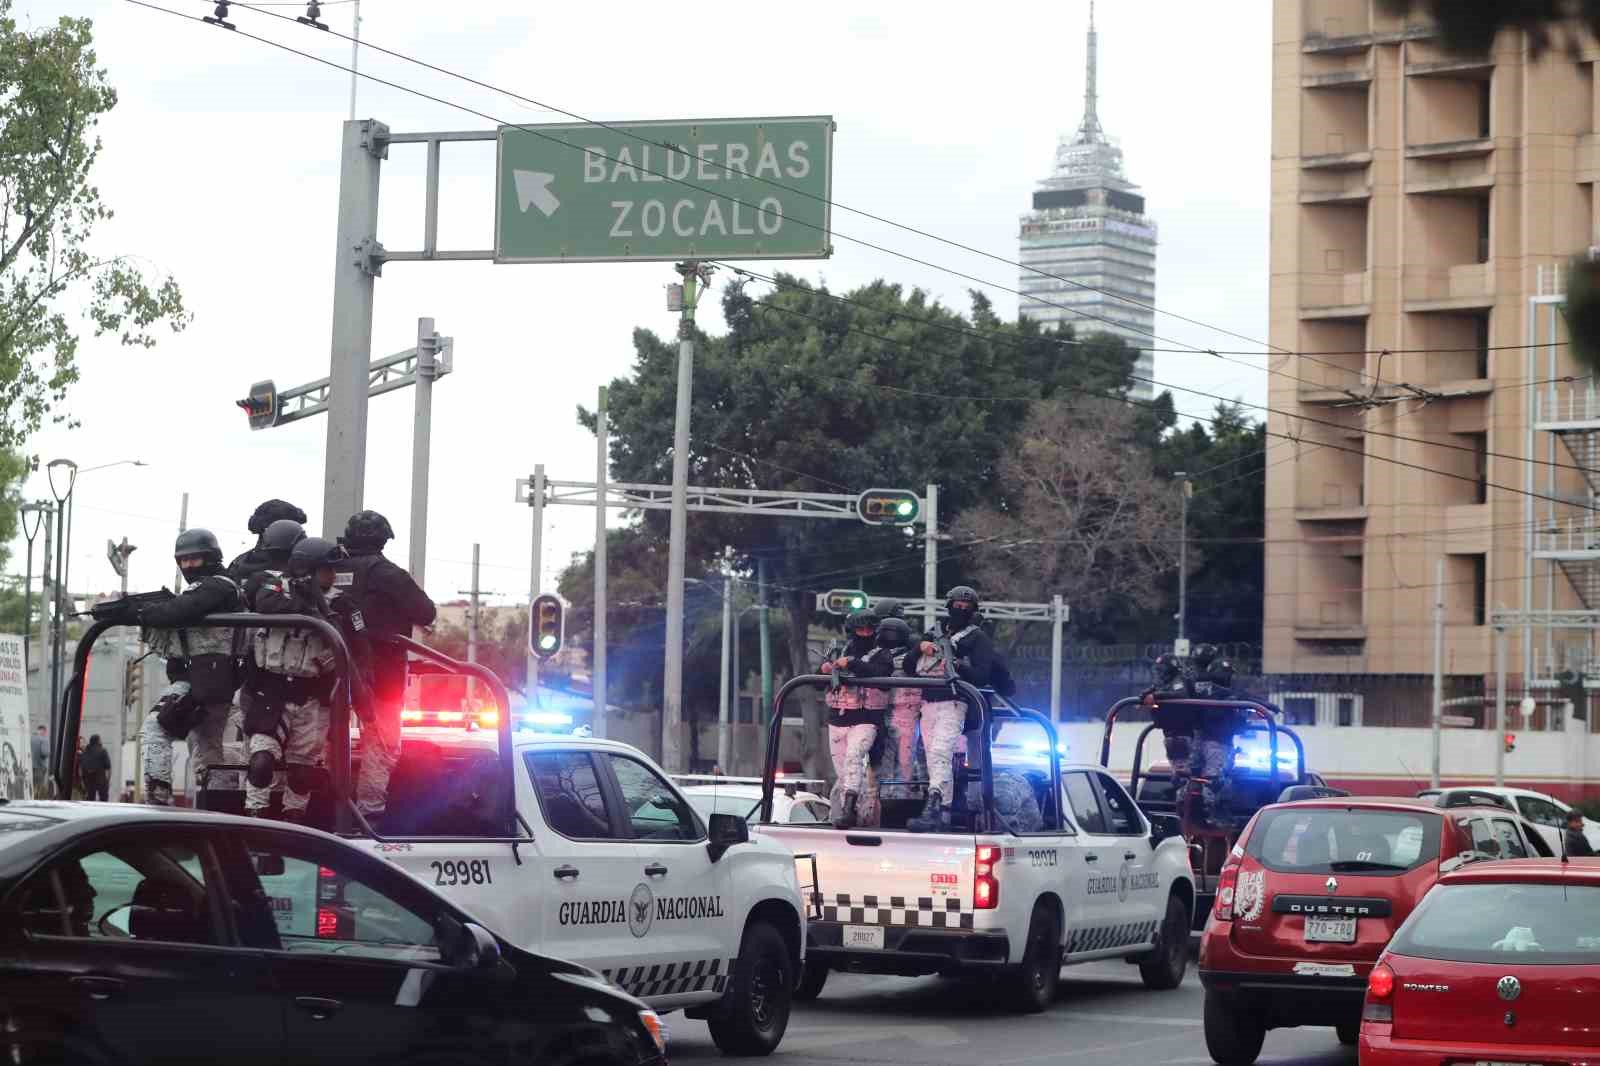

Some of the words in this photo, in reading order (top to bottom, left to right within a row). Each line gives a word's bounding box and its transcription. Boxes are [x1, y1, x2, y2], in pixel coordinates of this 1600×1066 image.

[583, 141, 810, 183] BALDERAS
[609, 197, 784, 237] ZOCALO
[430, 859, 492, 886] 29981
[559, 900, 626, 925] GUARDIA
[656, 896, 724, 920] NACIONAL
[1291, 904, 1369, 914] DUSTER
[1403, 983, 1449, 992] POINTER
